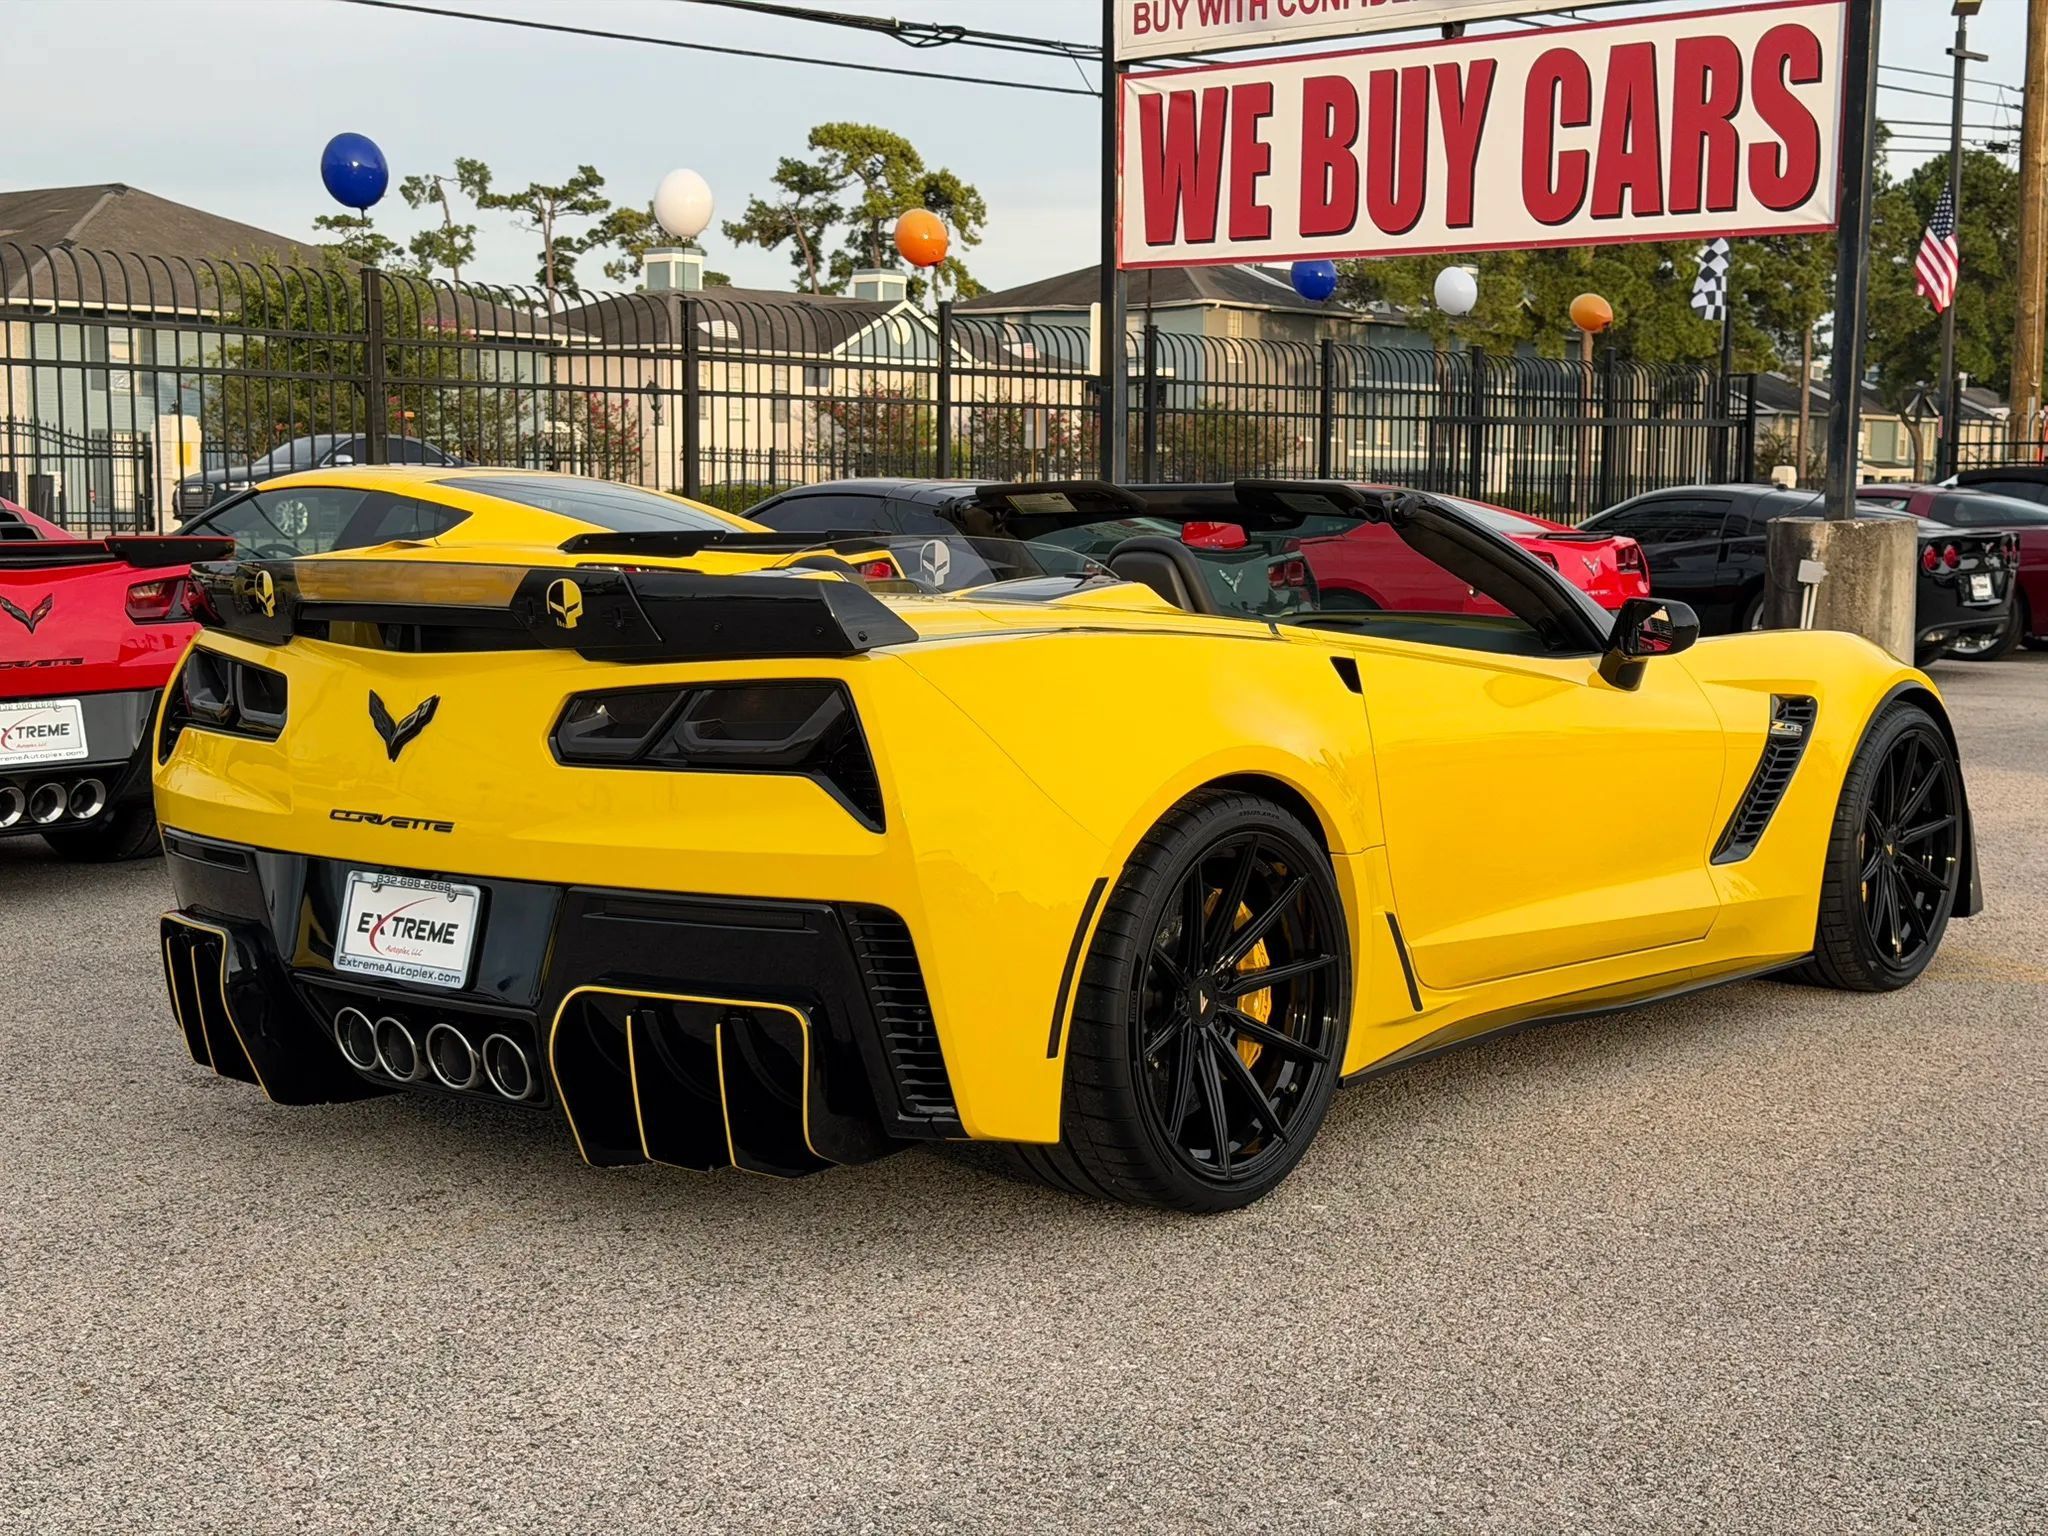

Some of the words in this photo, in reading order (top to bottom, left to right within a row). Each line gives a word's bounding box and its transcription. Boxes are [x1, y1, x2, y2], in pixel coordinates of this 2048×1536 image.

[1133, 0, 1188, 35] BUY
[1199, 0, 1268, 27] WITH
[1138, 81, 1273, 247] WE
[1299, 58, 1498, 238] BUY
[1522, 23, 1823, 226] CARS
[329, 809, 455, 833] CORVETTE
[356, 912, 459, 944] EXTREME
[338, 956, 461, 984] ExtremeAutoplex.com
